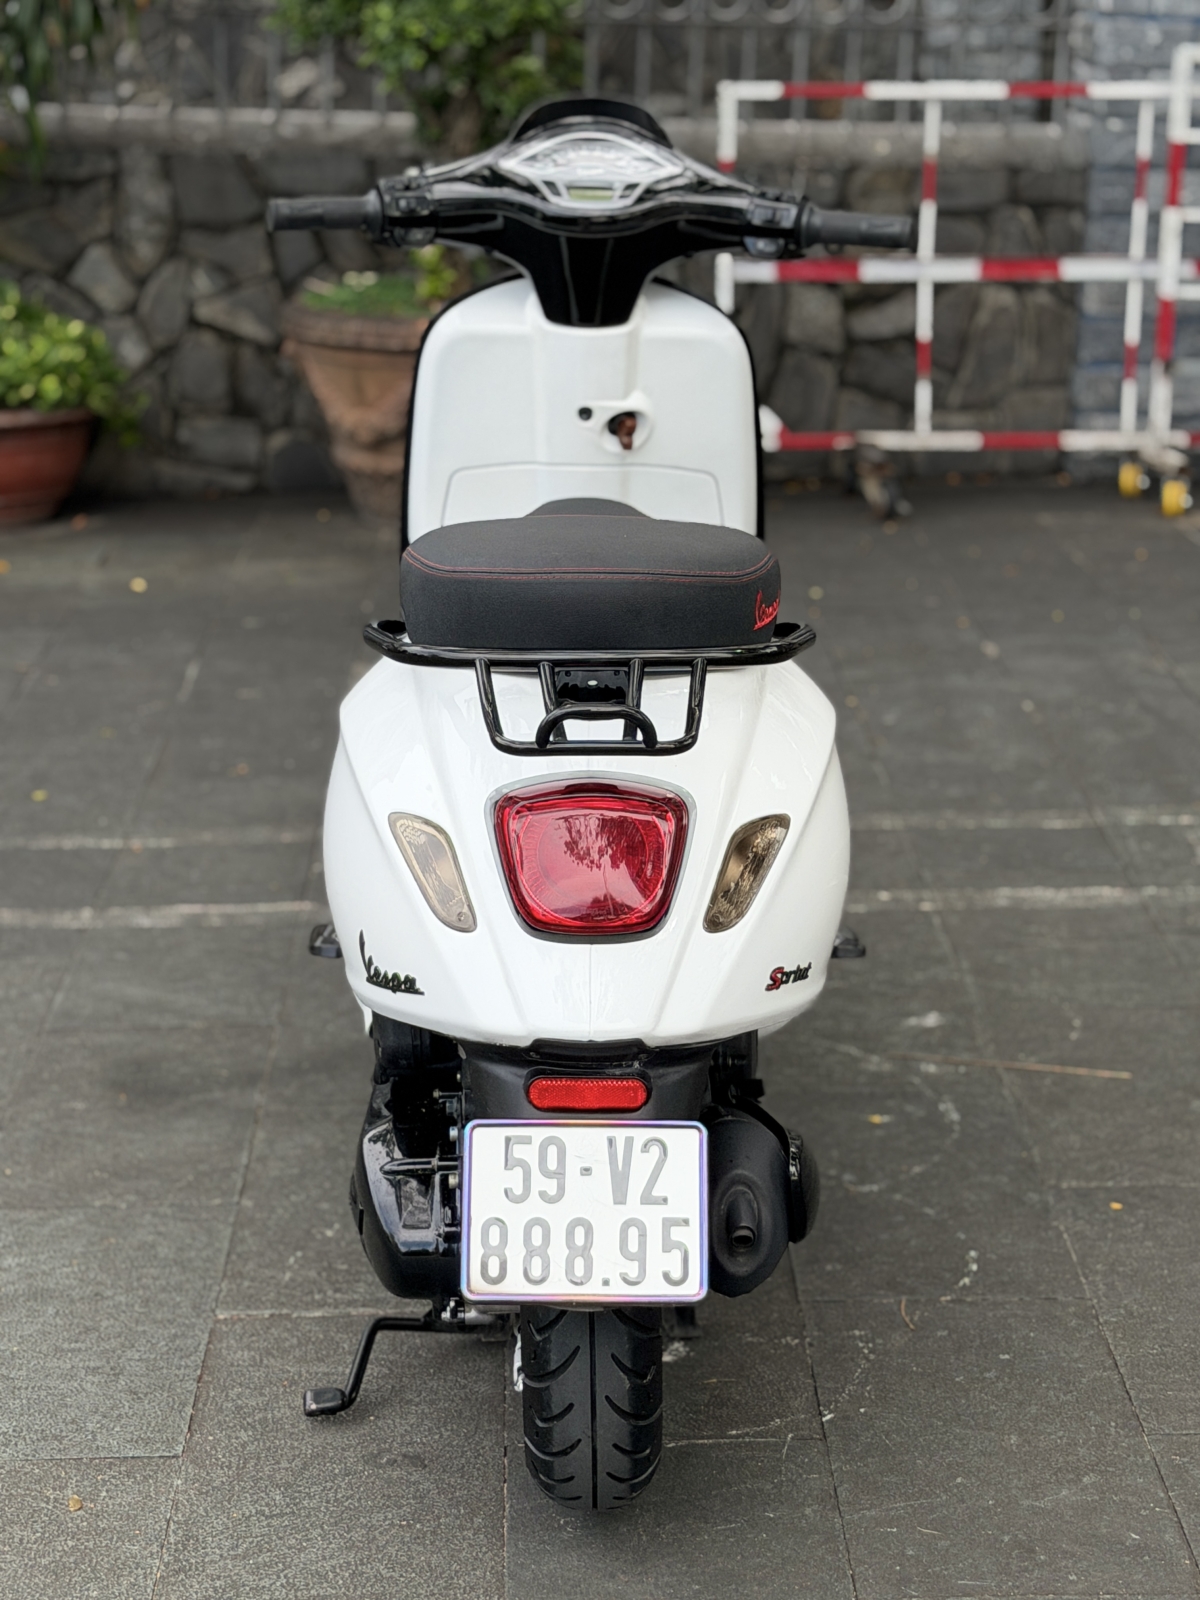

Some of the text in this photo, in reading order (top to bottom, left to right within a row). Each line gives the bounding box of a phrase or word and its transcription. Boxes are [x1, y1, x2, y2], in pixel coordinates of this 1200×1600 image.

[358, 928, 425, 996] Vespa
[764, 961, 812, 992] Sprint
[503, 1135, 669, 1205] 59-V2
[480, 1216, 690, 1287] 888.95
